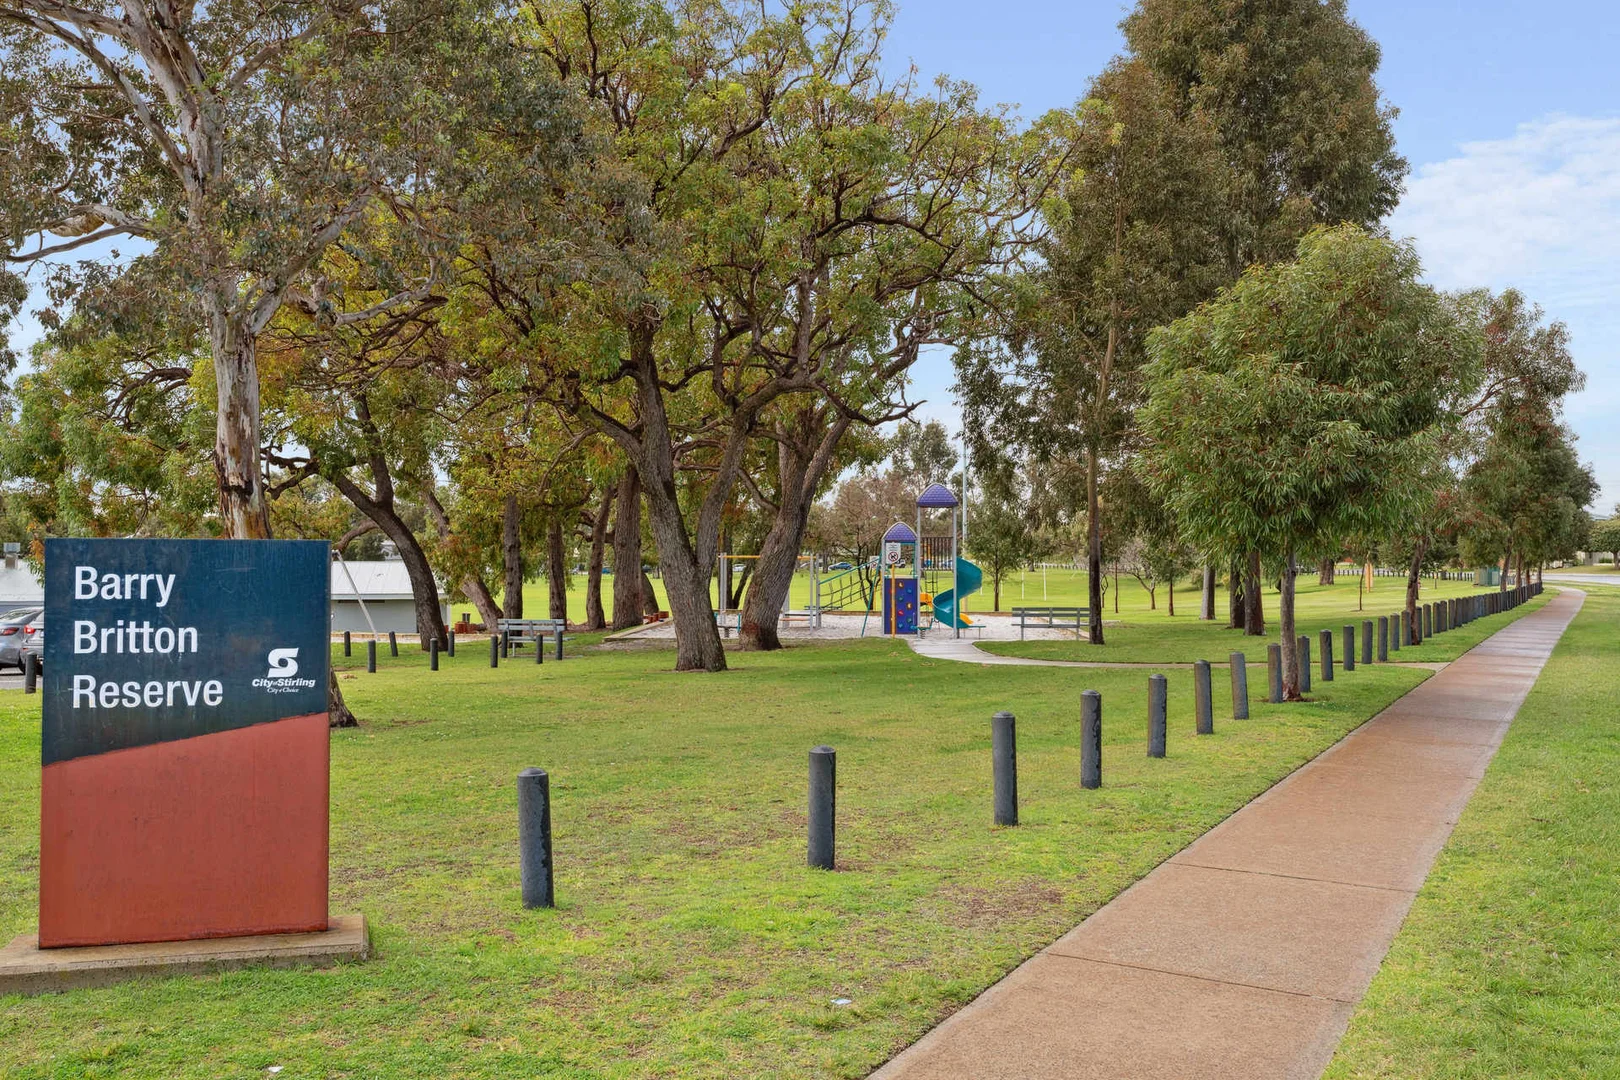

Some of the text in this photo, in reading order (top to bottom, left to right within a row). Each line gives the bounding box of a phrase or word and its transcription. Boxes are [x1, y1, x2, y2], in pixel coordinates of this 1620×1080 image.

[74, 566, 176, 608] Barry
[74, 619, 198, 654] Britton
[72, 674, 223, 709] Reserve
[252, 678, 273, 688] City
[278, 678, 316, 687] Stirling
